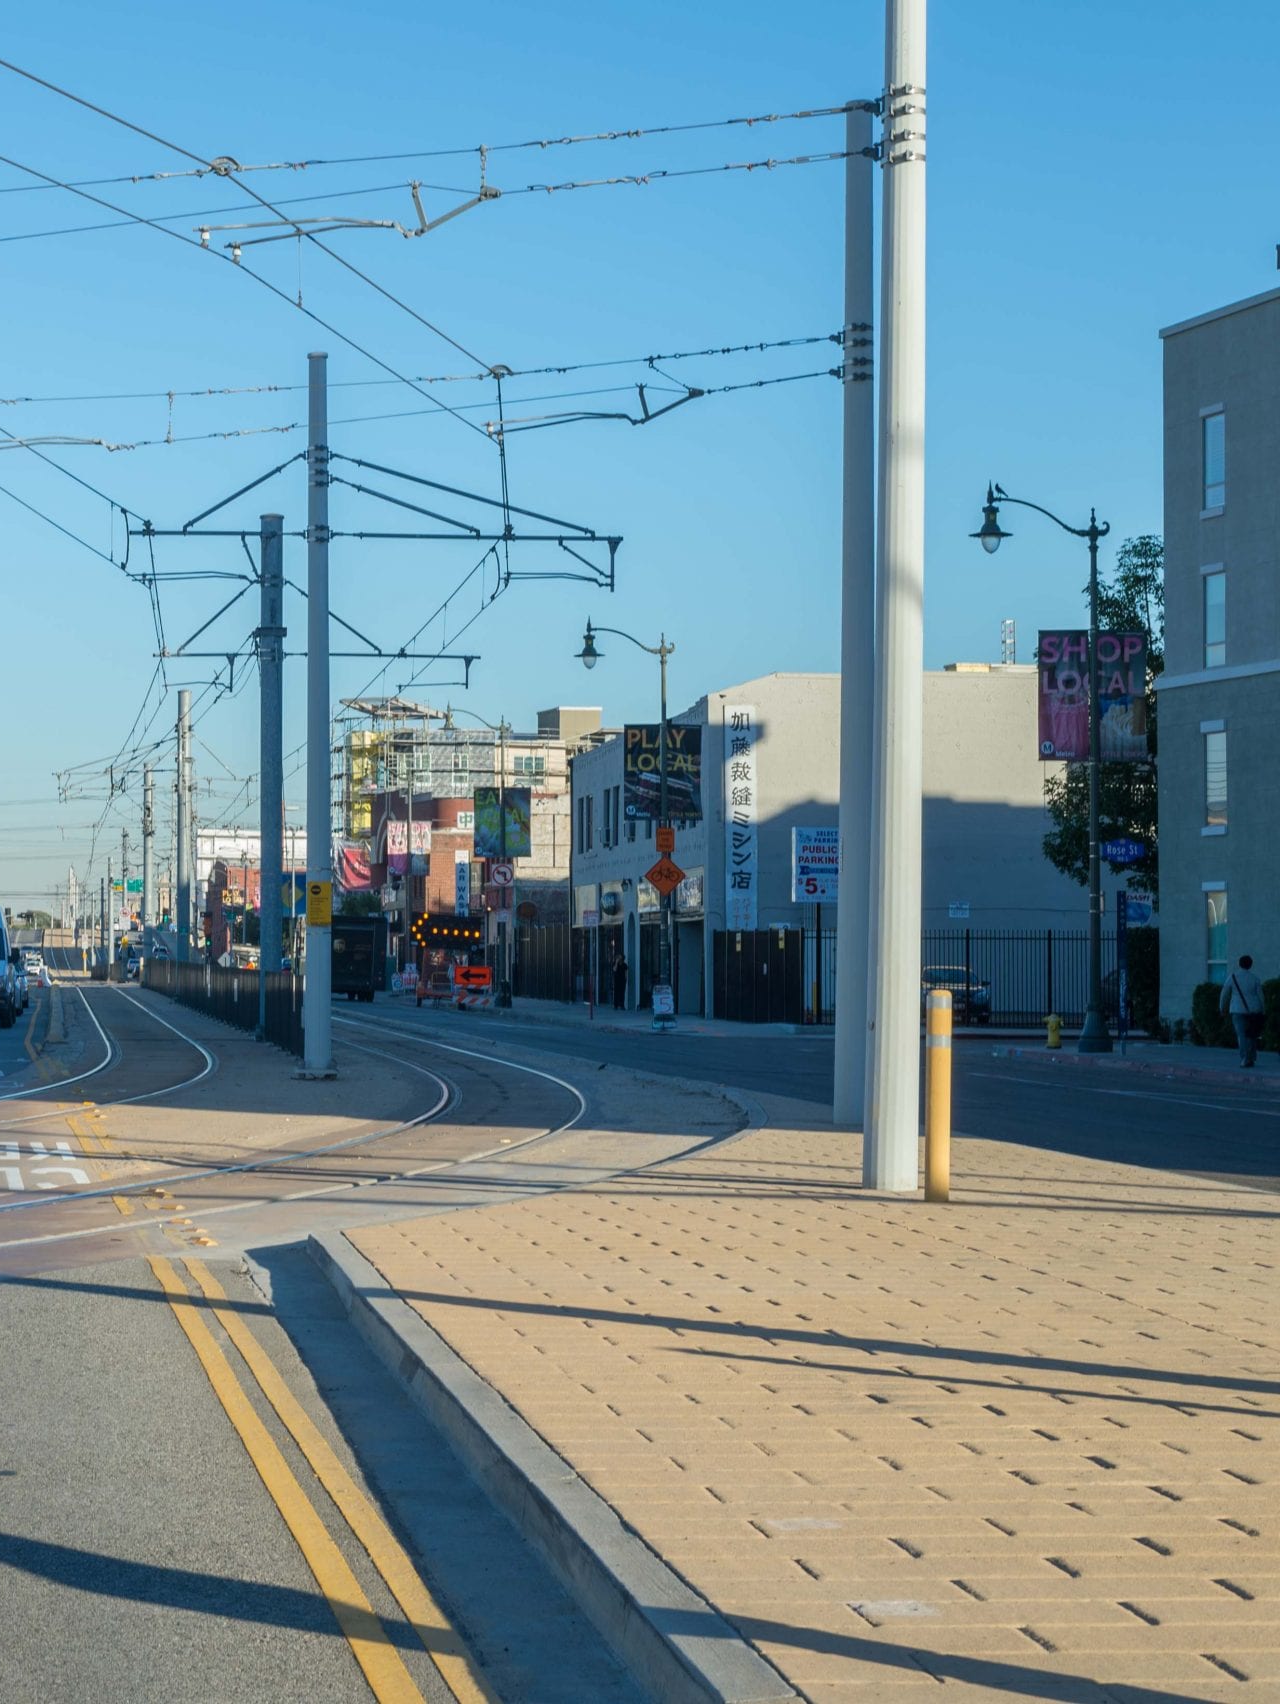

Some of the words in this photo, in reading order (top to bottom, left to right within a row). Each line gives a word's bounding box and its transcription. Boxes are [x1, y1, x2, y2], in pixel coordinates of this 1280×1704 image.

[1040, 635, 1143, 664] SHOP
[627, 729, 687, 749] PLAY
[802, 845, 838, 854] PUBLIC
[1107, 844, 1126, 856] Rose
[1129, 844, 1138, 856] St
